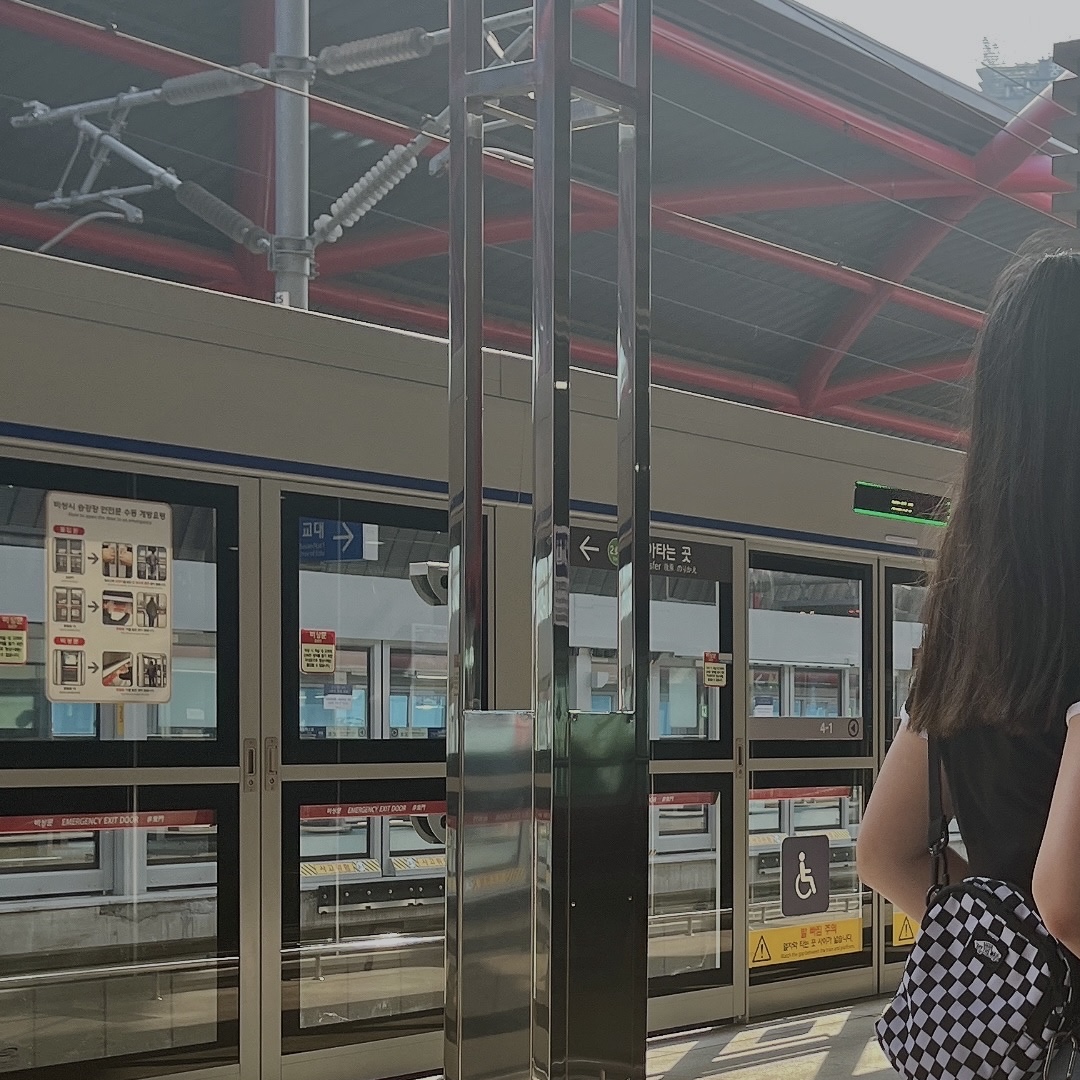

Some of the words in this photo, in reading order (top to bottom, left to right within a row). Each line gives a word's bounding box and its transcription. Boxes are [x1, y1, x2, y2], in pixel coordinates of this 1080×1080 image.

[302, 522, 324, 539] 교대
[649, 543, 676, 561] 아타는
[681, 546, 692, 563] 곳
[820, 722, 833, 734] 4-1
[347, 805, 378, 814] EMERGENCY
[379, 805, 391, 813] EXIT
[391, 804, 407, 812] DOOR
[61, 817, 102, 827] EMERGENCY
[103, 816, 118, 825] EXIT
[119, 815, 139, 825] DOOR
[825, 923, 837, 934] 주의
[818, 936, 832, 946] 사이가
